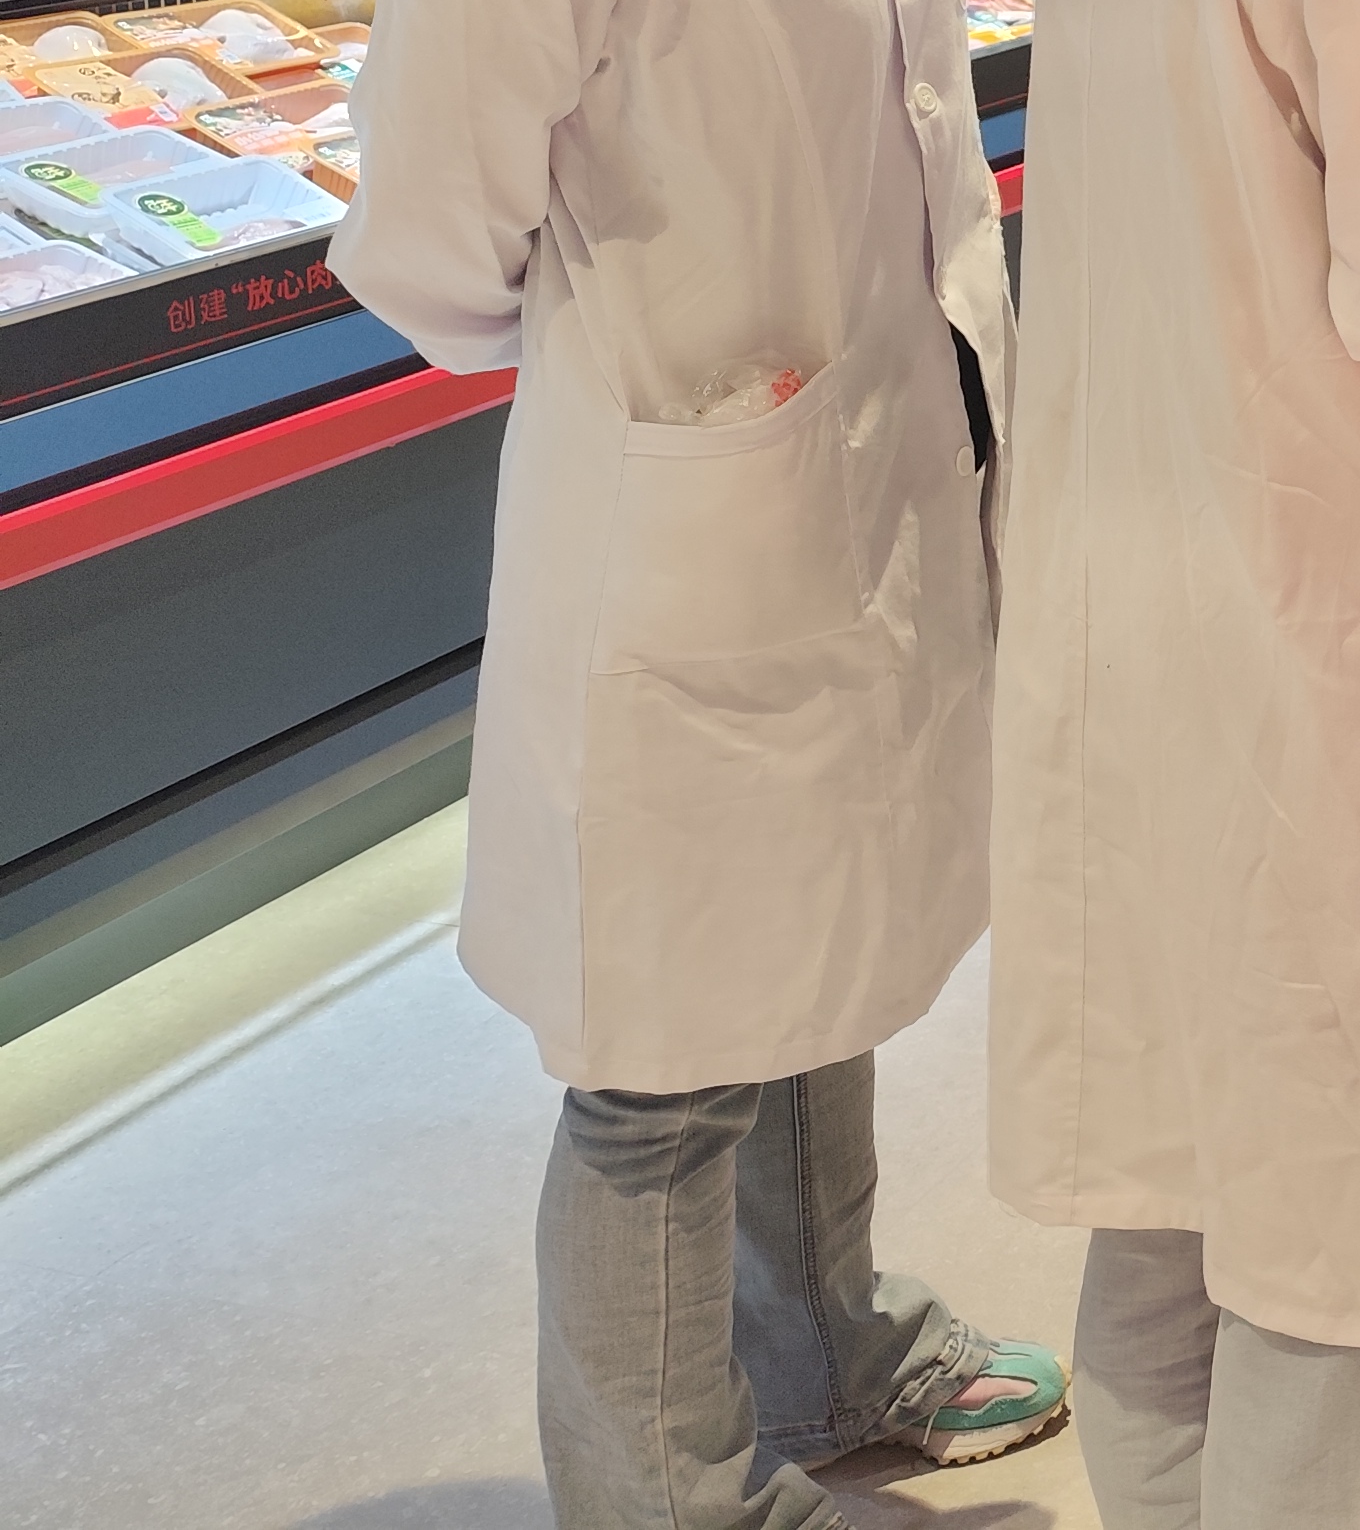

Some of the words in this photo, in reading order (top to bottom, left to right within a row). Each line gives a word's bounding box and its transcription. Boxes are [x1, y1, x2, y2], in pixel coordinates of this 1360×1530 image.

[167, 258, 340, 333] 创建“放心肉
